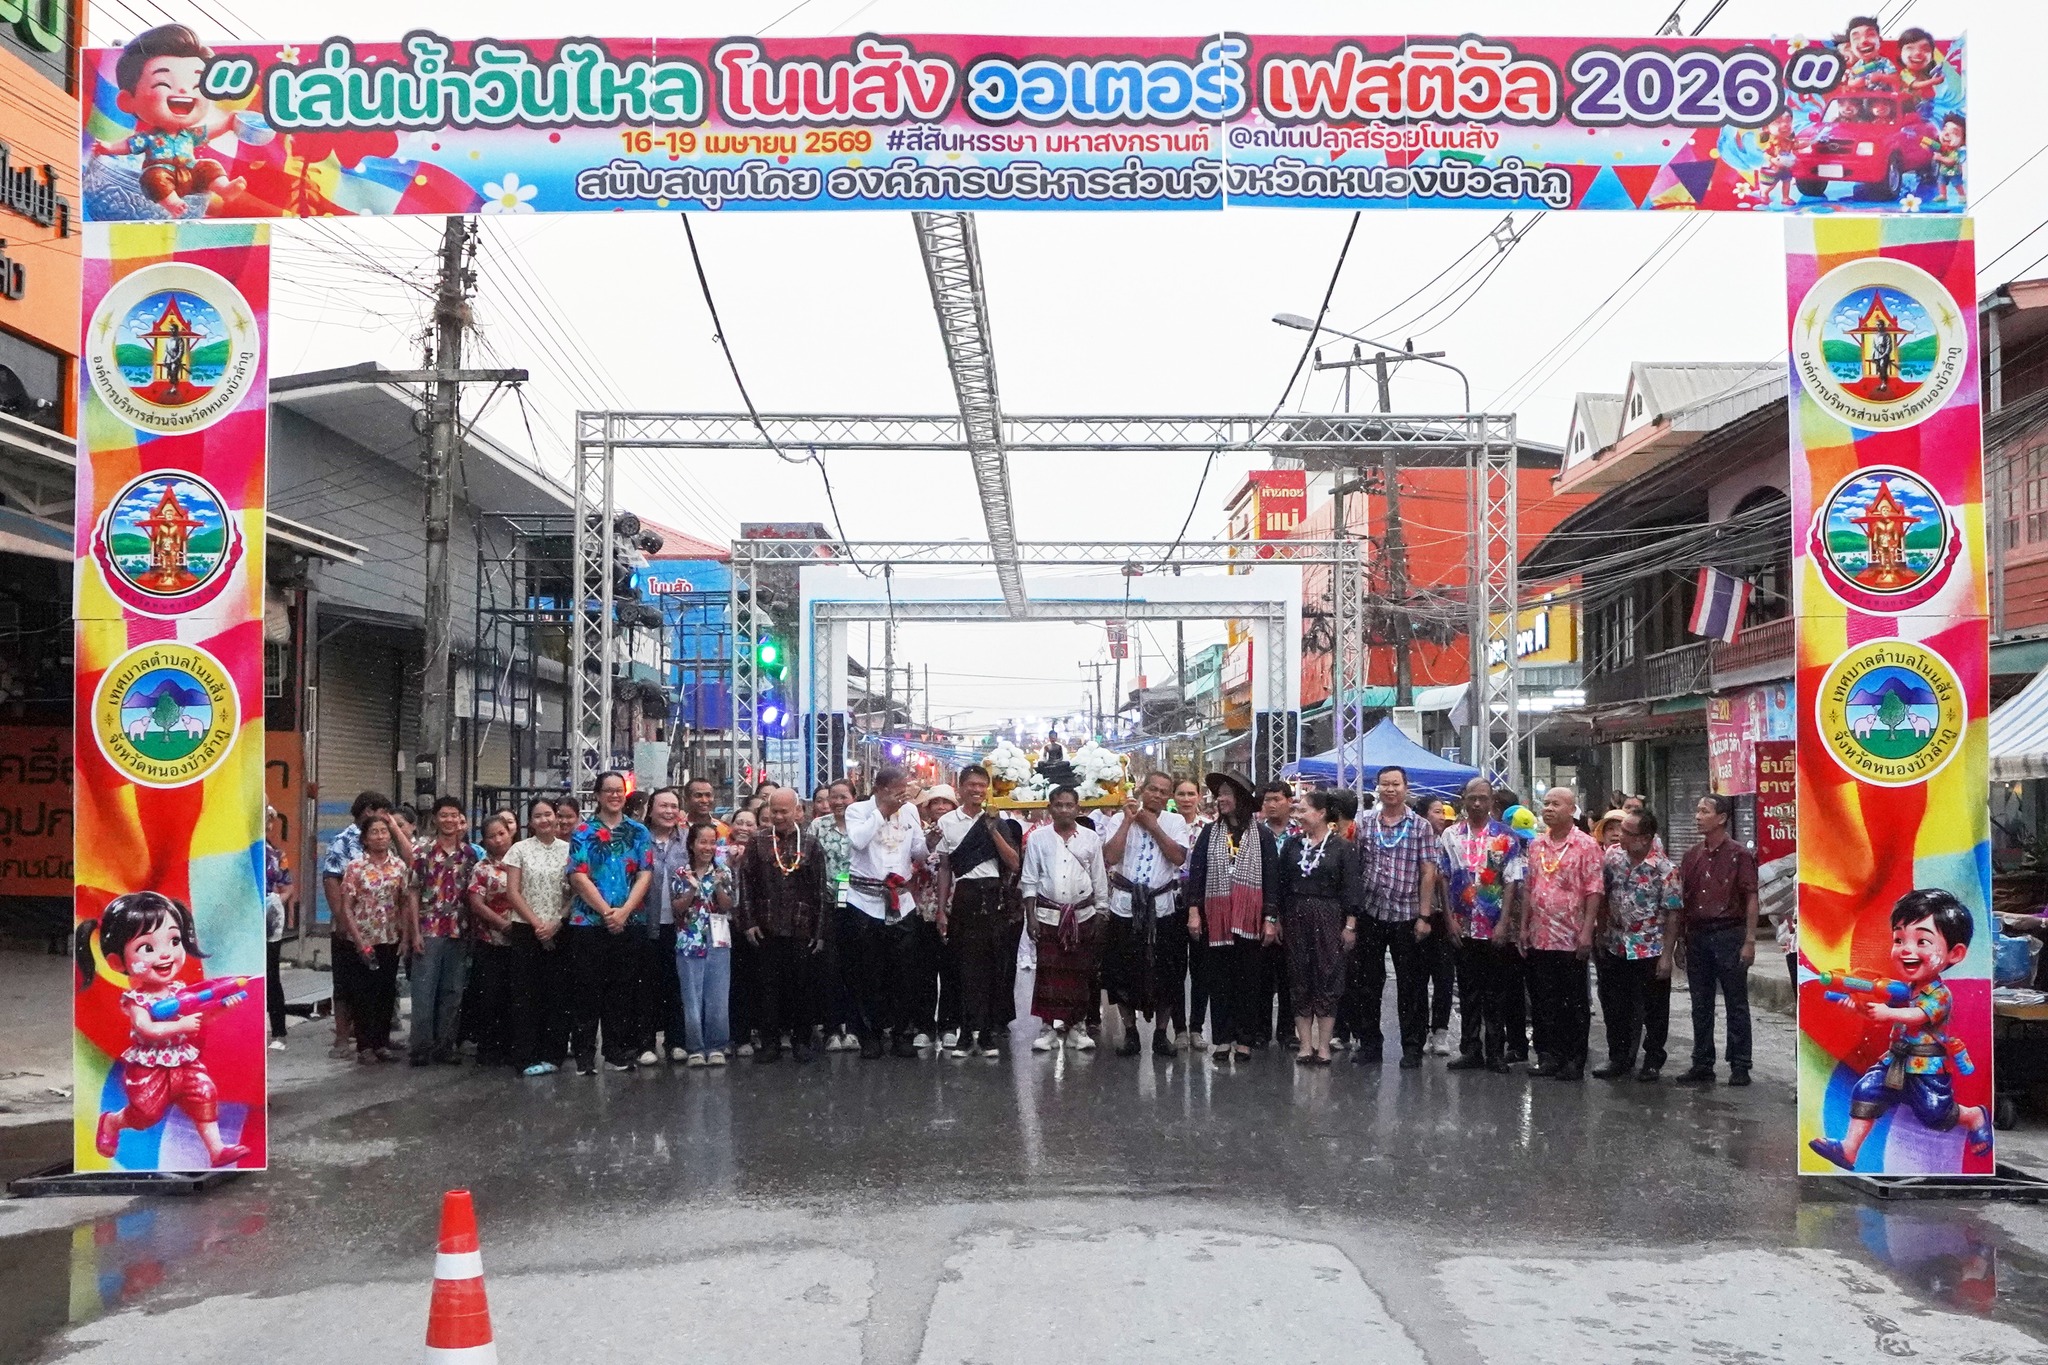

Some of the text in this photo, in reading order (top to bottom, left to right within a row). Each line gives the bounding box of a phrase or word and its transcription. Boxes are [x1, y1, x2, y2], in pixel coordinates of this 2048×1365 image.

[272, 44, 698, 122] เล่นน้ำวันไหล
[720, 45, 950, 116] โนนสัง
[973, 44, 1240, 115] วอเตอร์
[1269, 45, 1550, 115] เฟสติวัล
[1574, 56, 1773, 116] 2026
[621, 124, 1499, 154] 16-19 เมษายน 2569 #สีสันหรรษา มหาสงกรานต์ @ถนนปลาสร้อยโนนสัง
[579, 162, 820, 207] สนับสนุนโดย
[107, 651, 227, 706] เทศบาลตำบลโนนสัง
[1832, 648, 1953, 703] เทศบาลตำบลโนนสัง
[108, 729, 231, 778] จังหวัดหนองบัวลำภู
[1833, 728, 1958, 776] จังหวัดหนองบัวลำภู
